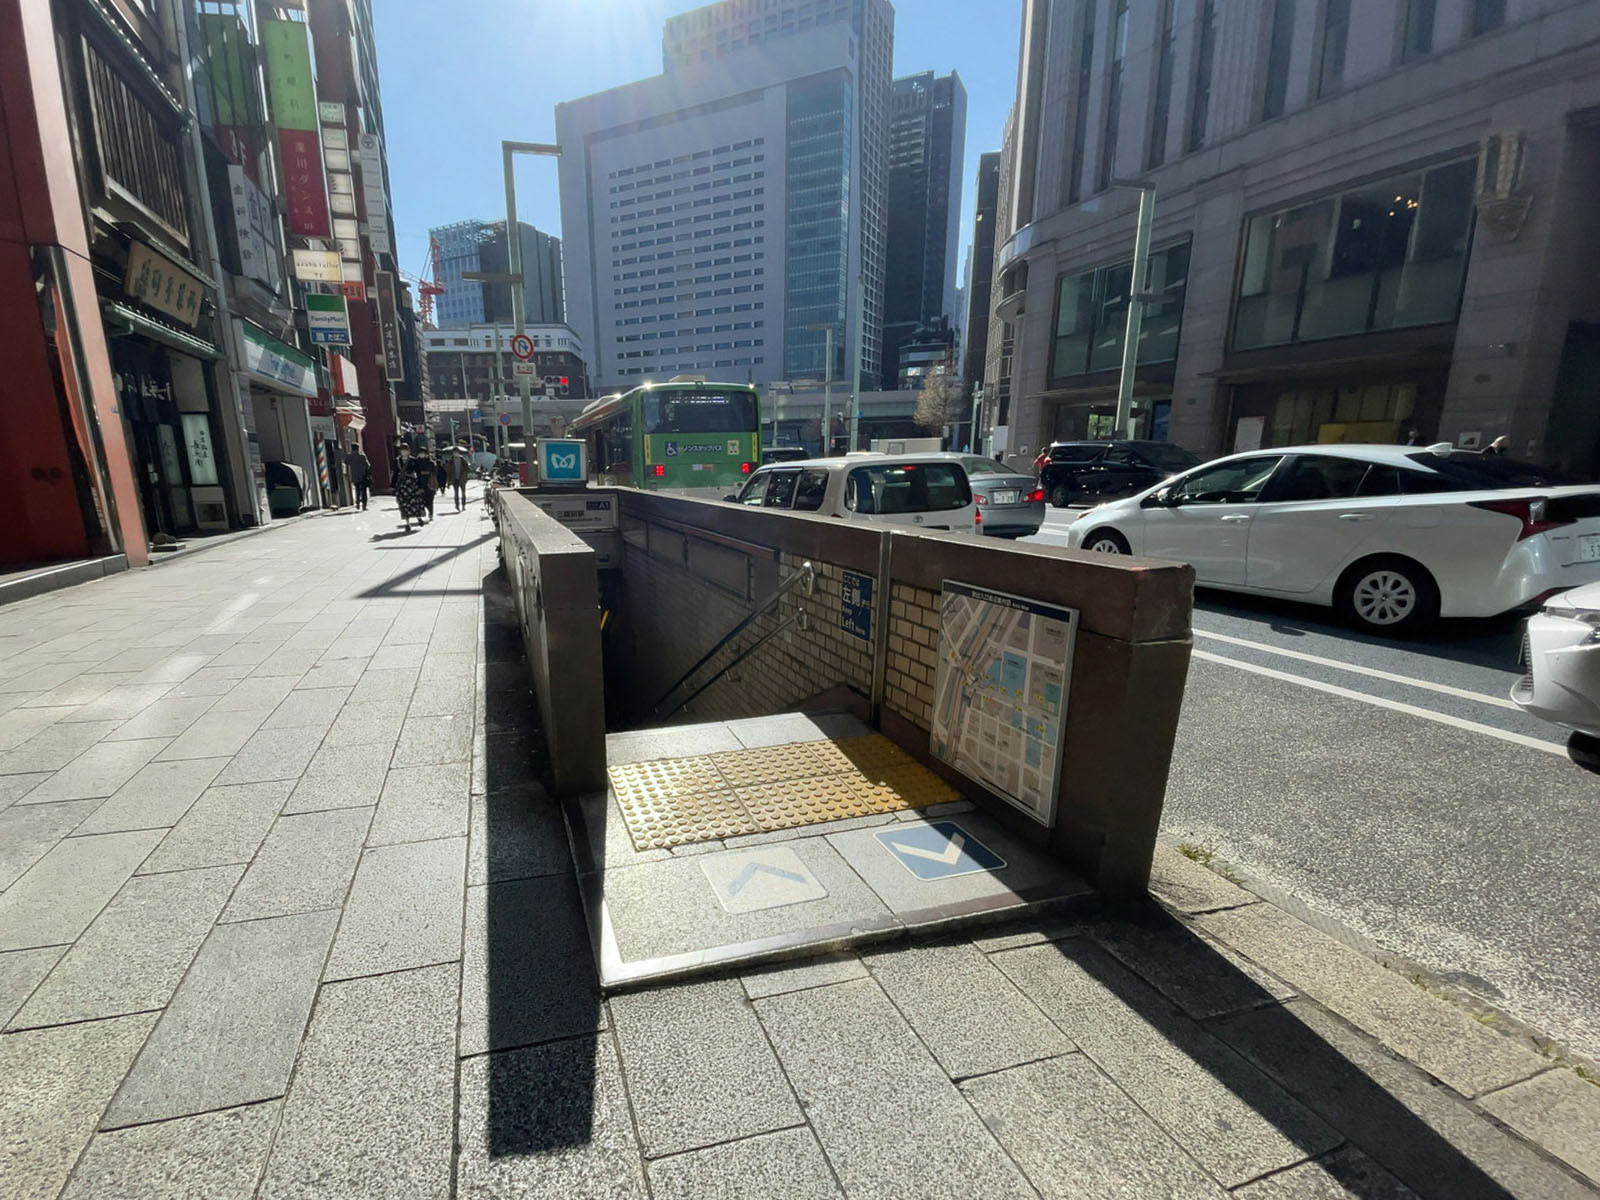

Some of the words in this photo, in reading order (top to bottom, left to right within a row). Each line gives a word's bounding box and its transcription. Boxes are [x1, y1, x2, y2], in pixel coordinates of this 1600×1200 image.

[311, 315, 345, 324] FamilyMart
[683, 444, 723, 452] ノンステップバス
[599, 502, 609, 510] A1
[842, 615, 855, 631] Left
